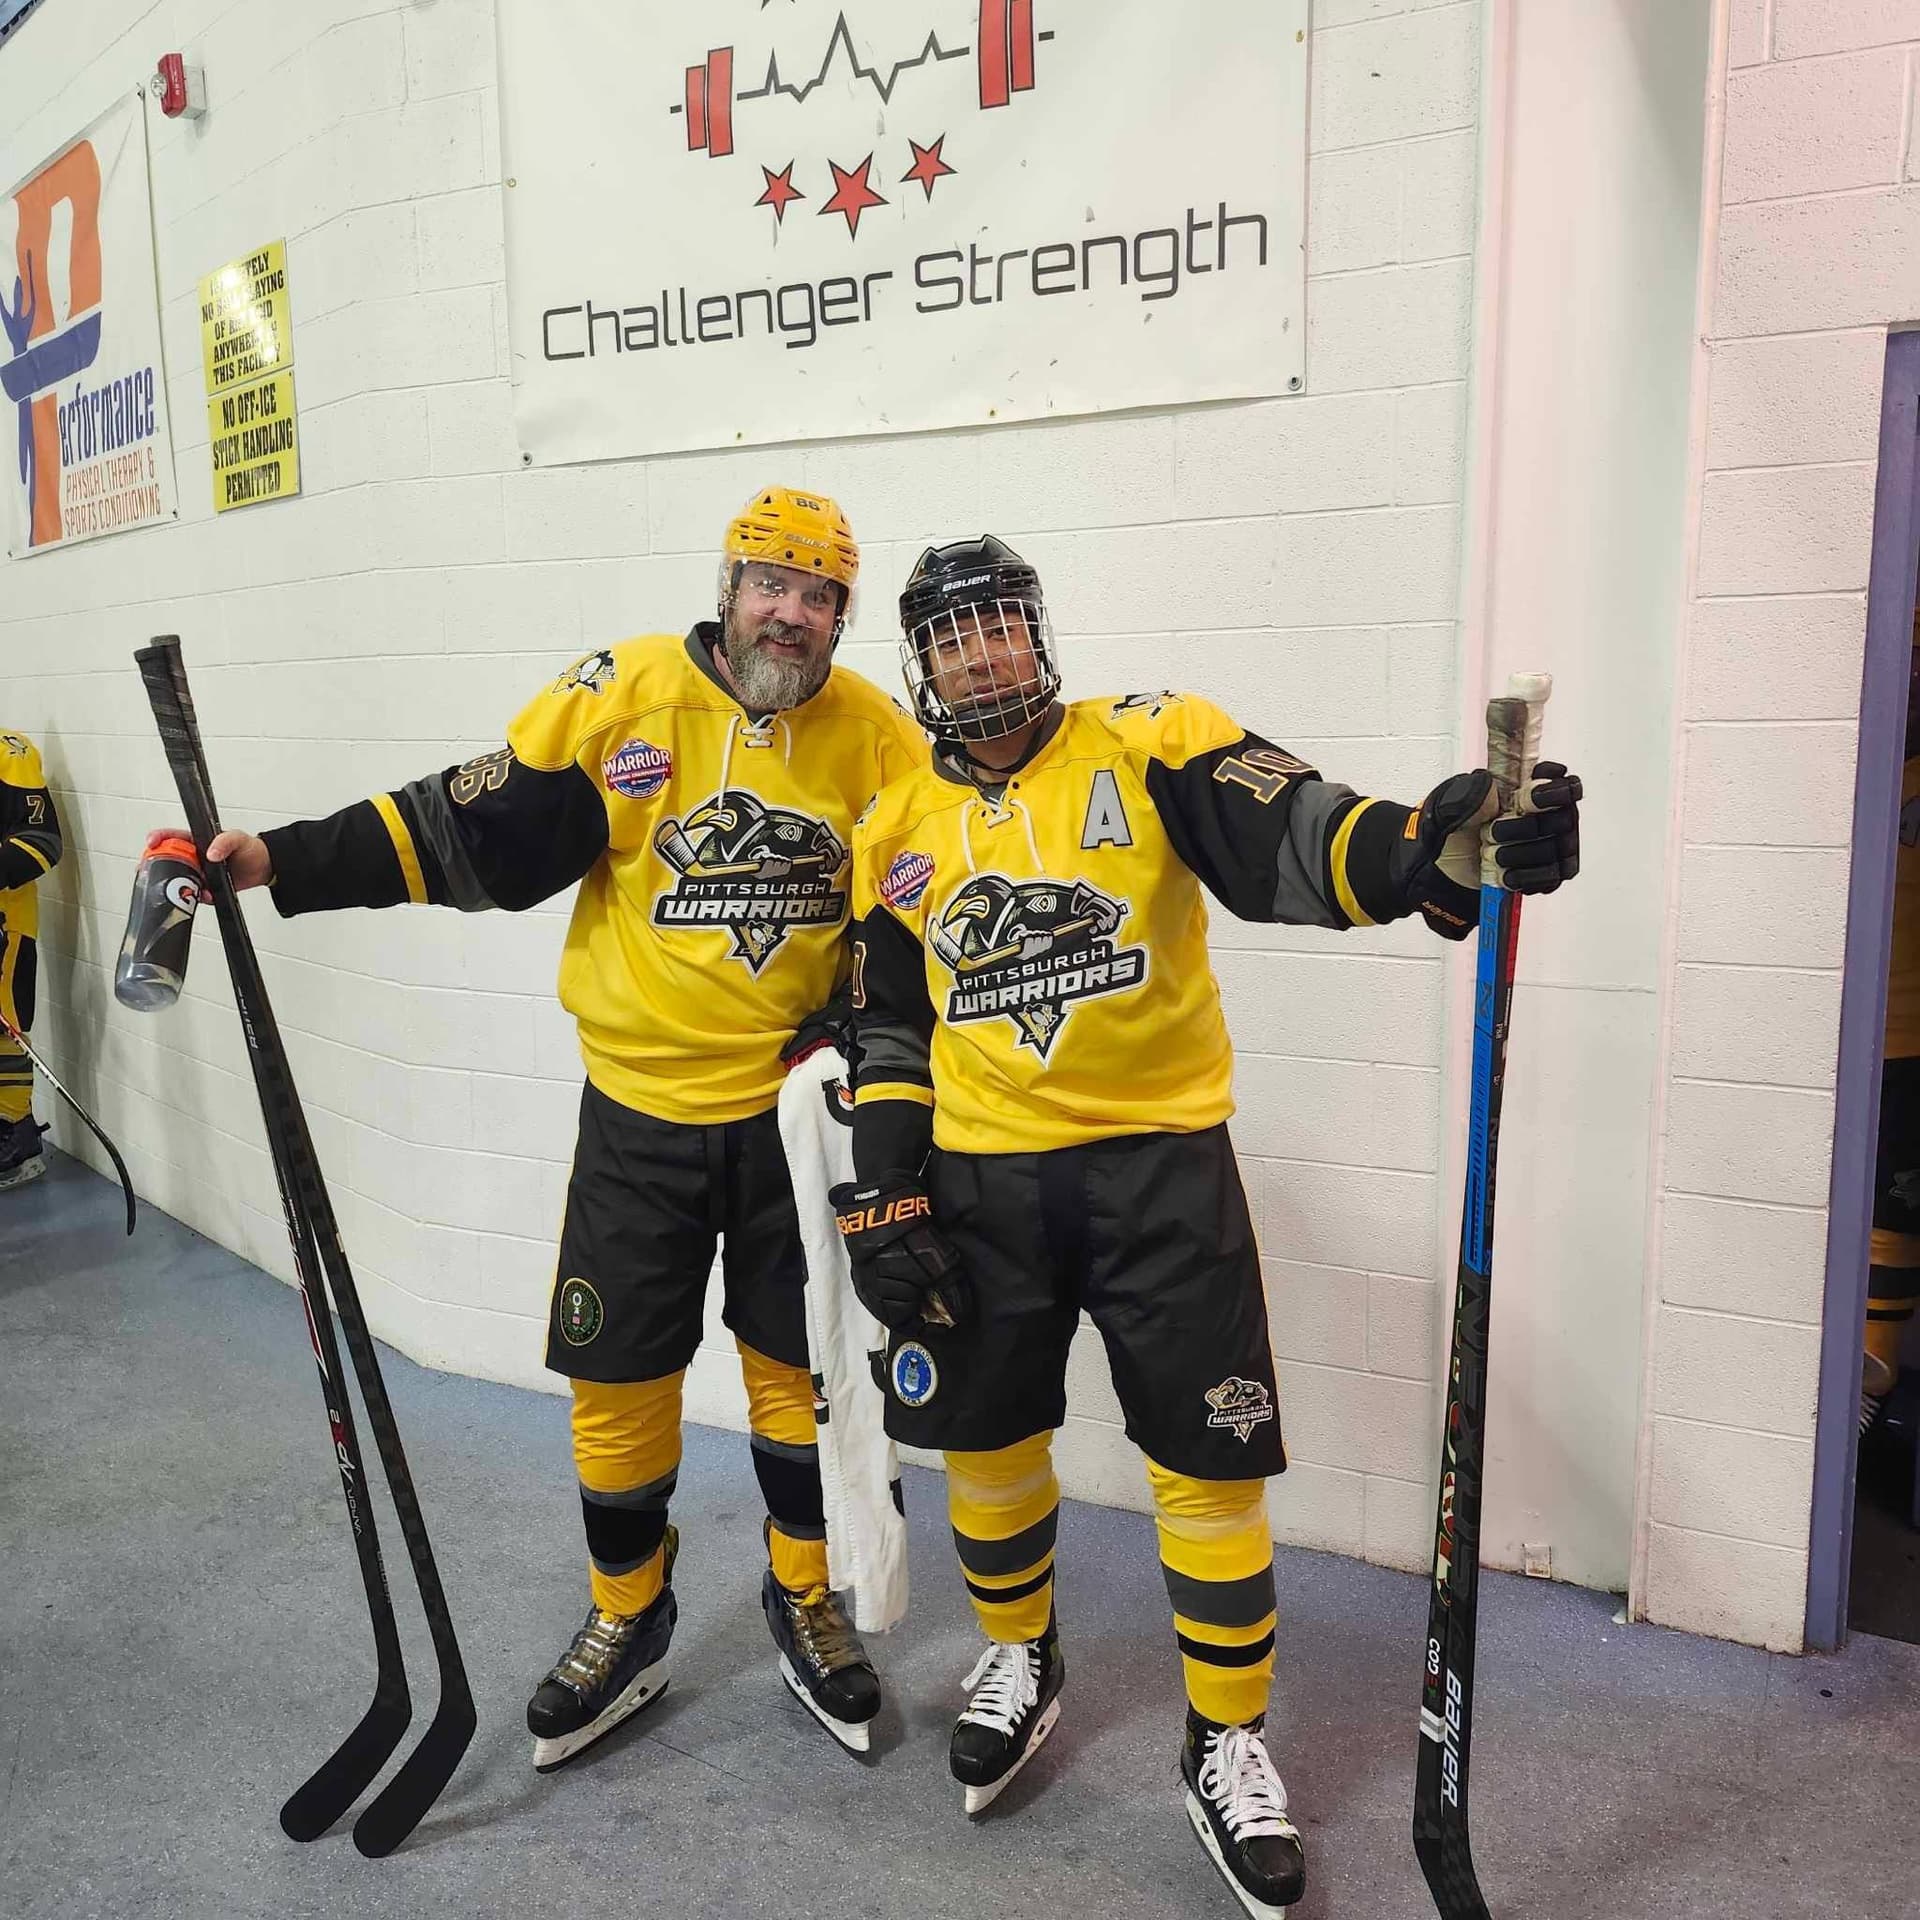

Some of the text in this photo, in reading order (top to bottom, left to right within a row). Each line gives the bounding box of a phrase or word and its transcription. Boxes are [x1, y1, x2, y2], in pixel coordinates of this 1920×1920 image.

[542, 202, 1267, 361] Challenger Strength
[202, 302, 214, 324] NO
[213, 362, 235, 385] THIS
[222, 382, 277, 430] NO OFF-ICE
[212, 417, 293, 471] STICK HANDLING
[66, 464, 106, 504] PHYSICAL
[106, 447, 145, 491] THERAPY
[225, 460, 281, 504] PERMITTED
[65, 483, 161, 537] SPORTS CONDITIONING
[941, 574, 992, 592] BAUER
[602, 750, 671, 777] WARRIOR
[1212, 748, 1319, 804] 10
[25, 794, 46, 825] 7
[1080, 769, 1134, 849] A
[685, 883, 827, 896] PITTSBURGH
[879, 853, 934, 897] WARRIOR
[663, 898, 840, 920] WARRIORS
[955, 956, 1137, 1015] WARRIORS
[961, 946, 1106, 991] PITTSBURGH
[834, 1196, 932, 1236] BAUER
[1212, 1408, 1271, 1425] WARRIORS
[1442, 1666, 1463, 1812] BAUER
